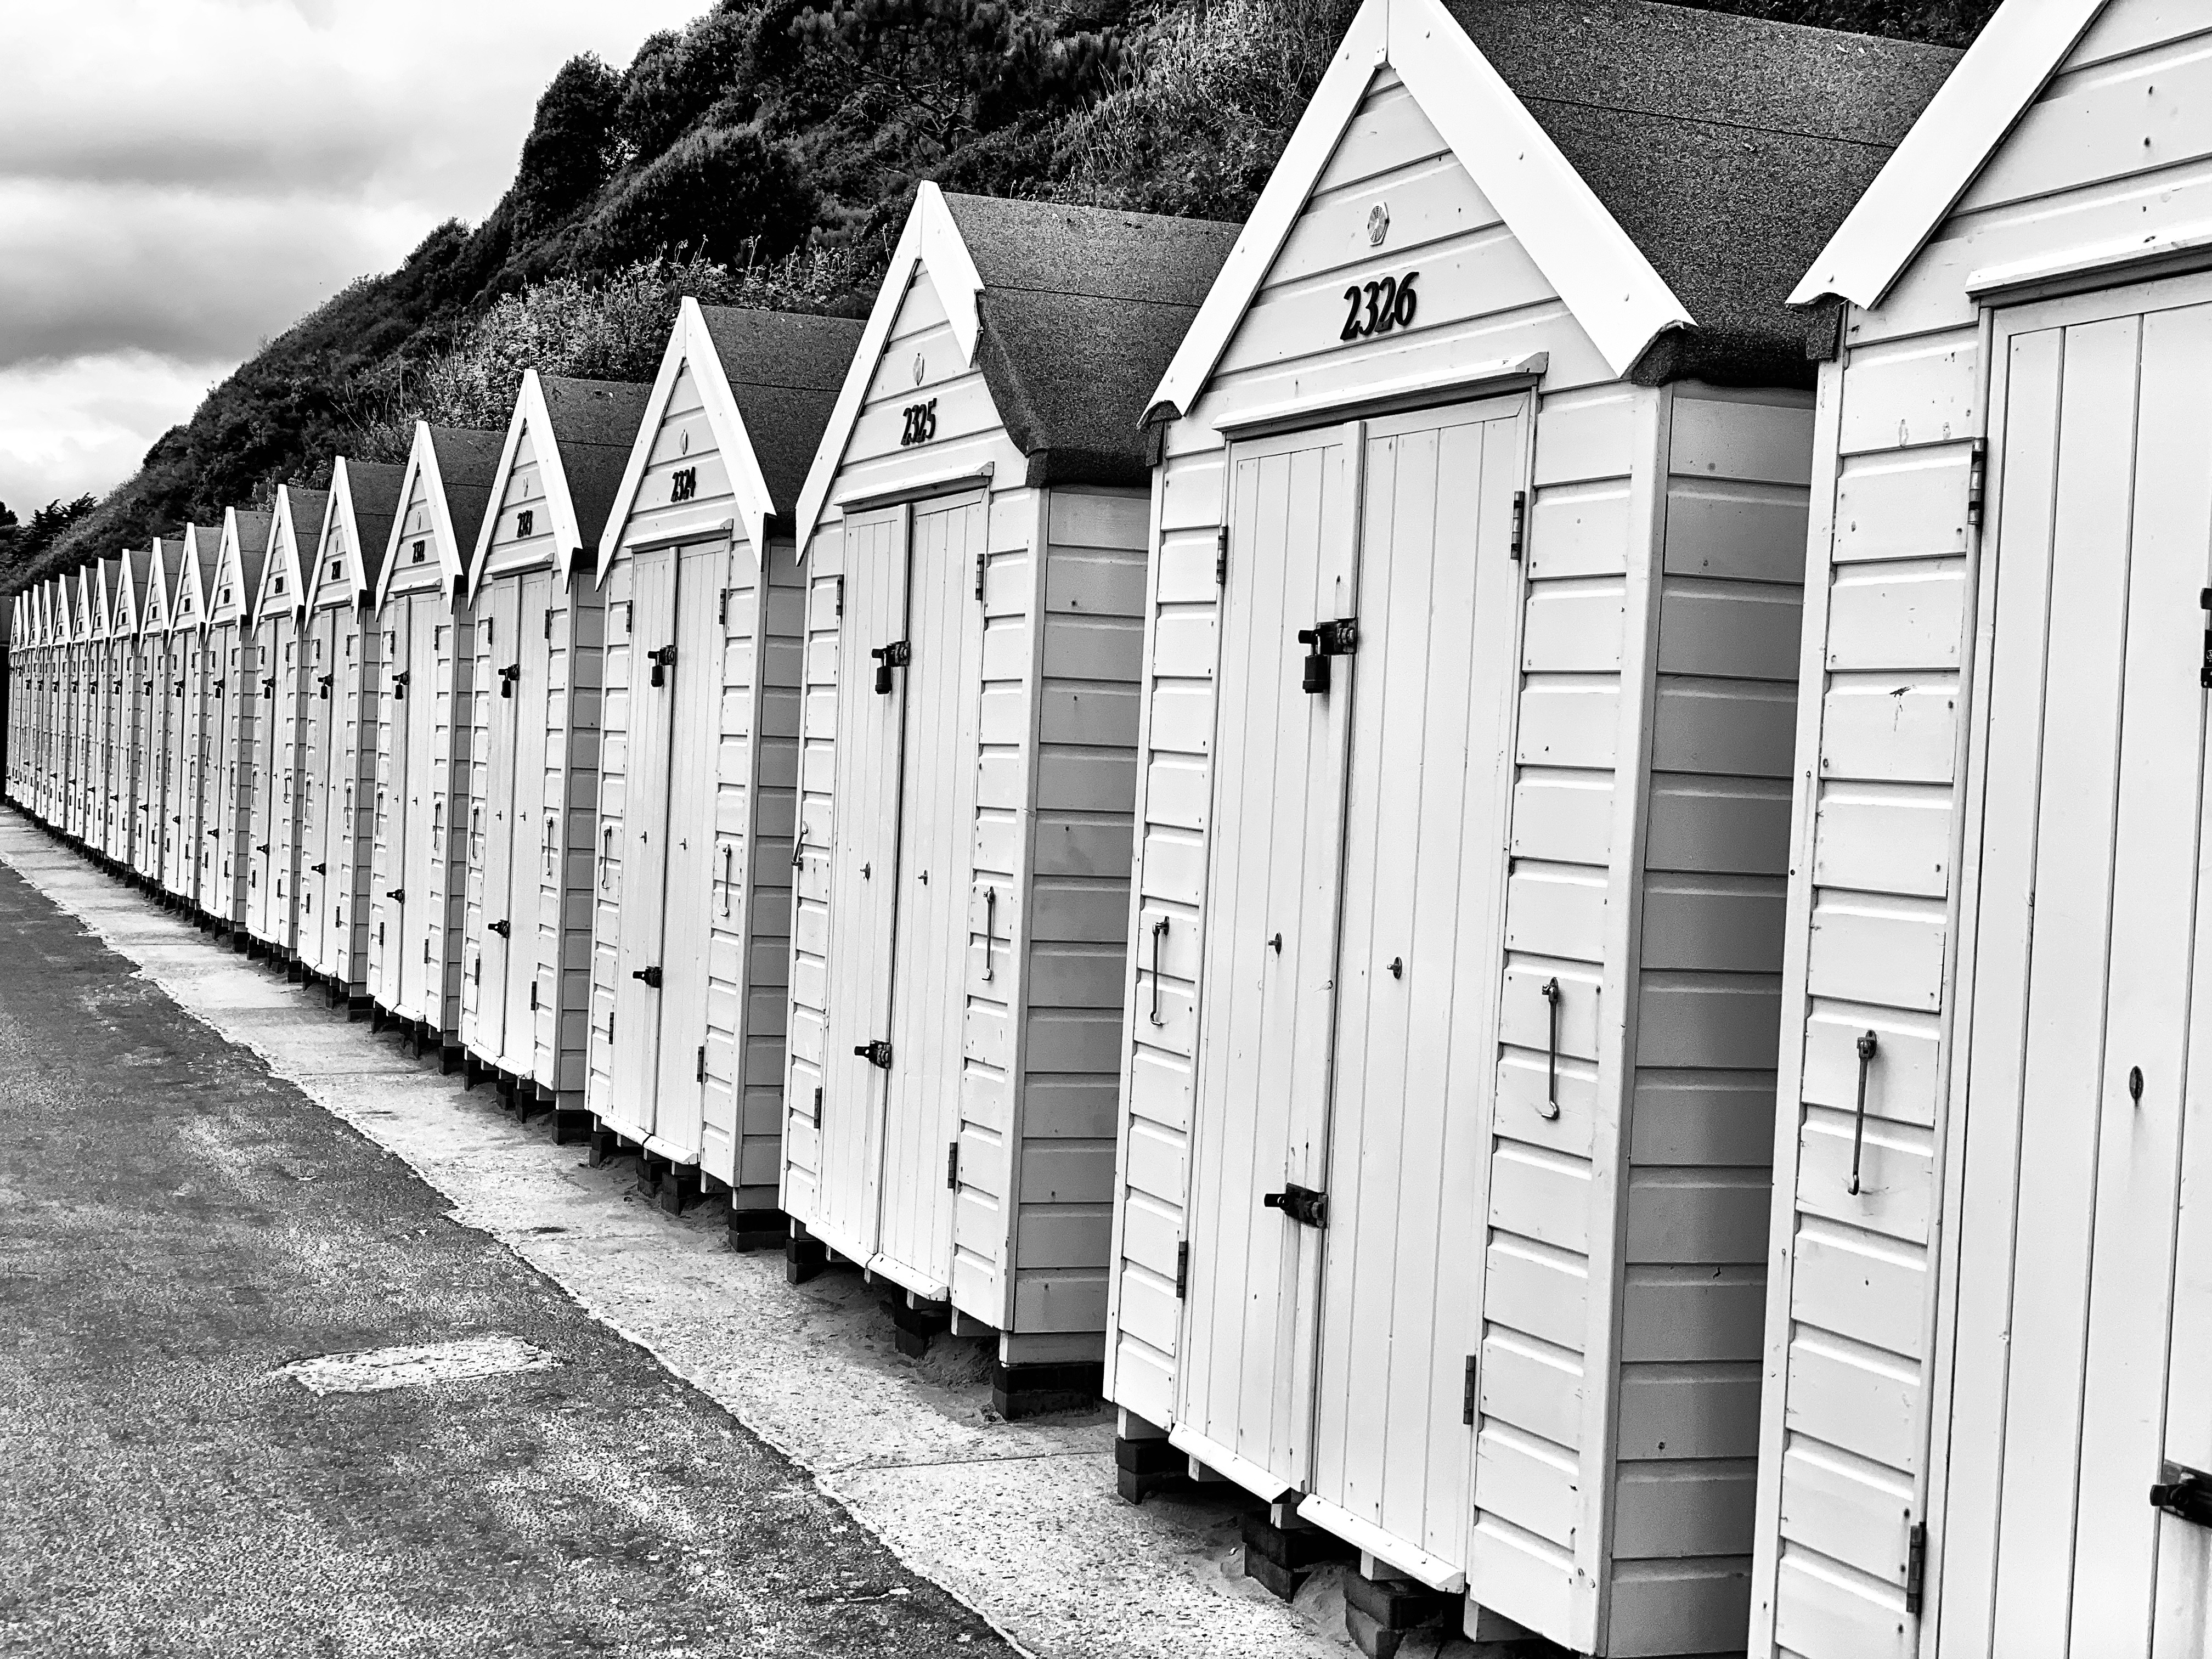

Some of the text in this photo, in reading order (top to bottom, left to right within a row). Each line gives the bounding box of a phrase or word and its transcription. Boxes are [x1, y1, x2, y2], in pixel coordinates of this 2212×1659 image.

[1340, 272, 1419, 340] 2326
[901, 398, 936, 445] 2325
[671, 467, 696, 502] 2324
